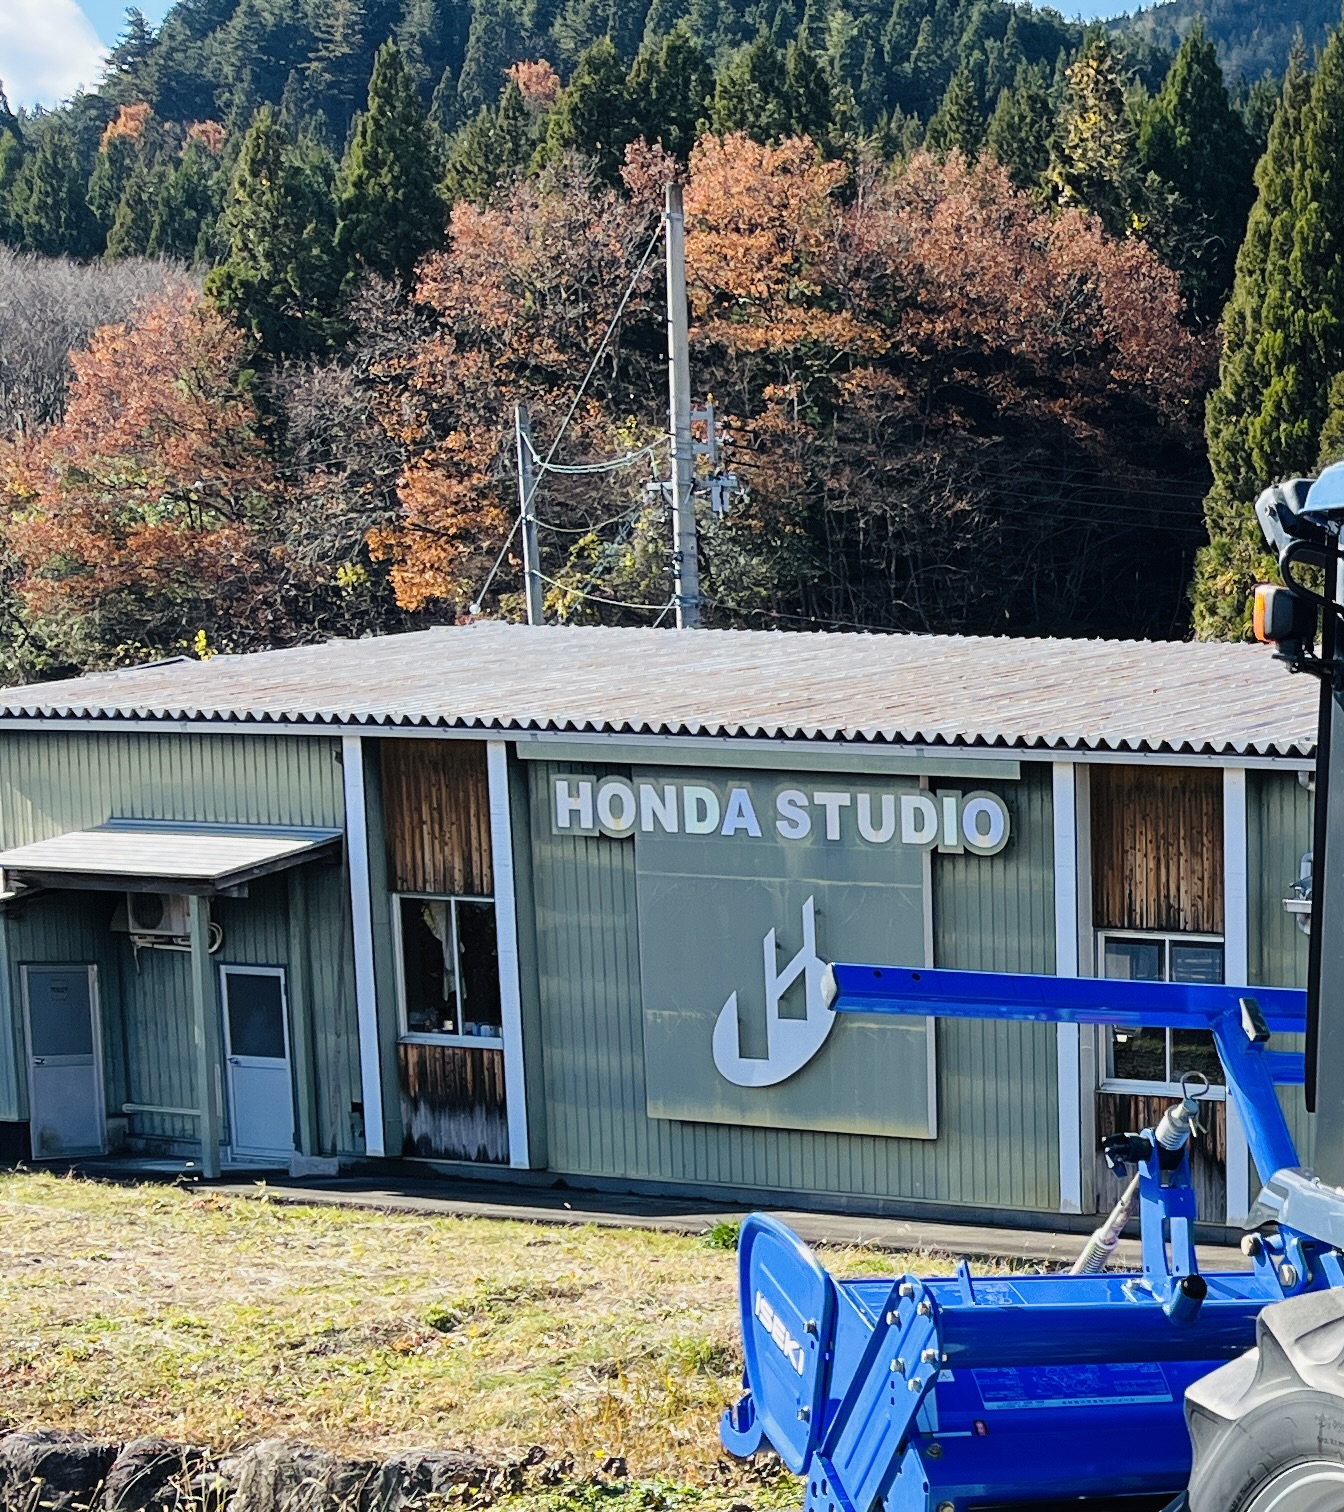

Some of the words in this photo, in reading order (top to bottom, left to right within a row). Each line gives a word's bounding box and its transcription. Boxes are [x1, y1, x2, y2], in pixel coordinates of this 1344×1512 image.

[554, 779, 763, 838] HONDA
[775, 789, 1005, 849] STUDIO
[755, 1290, 805, 1376] ISEKI
